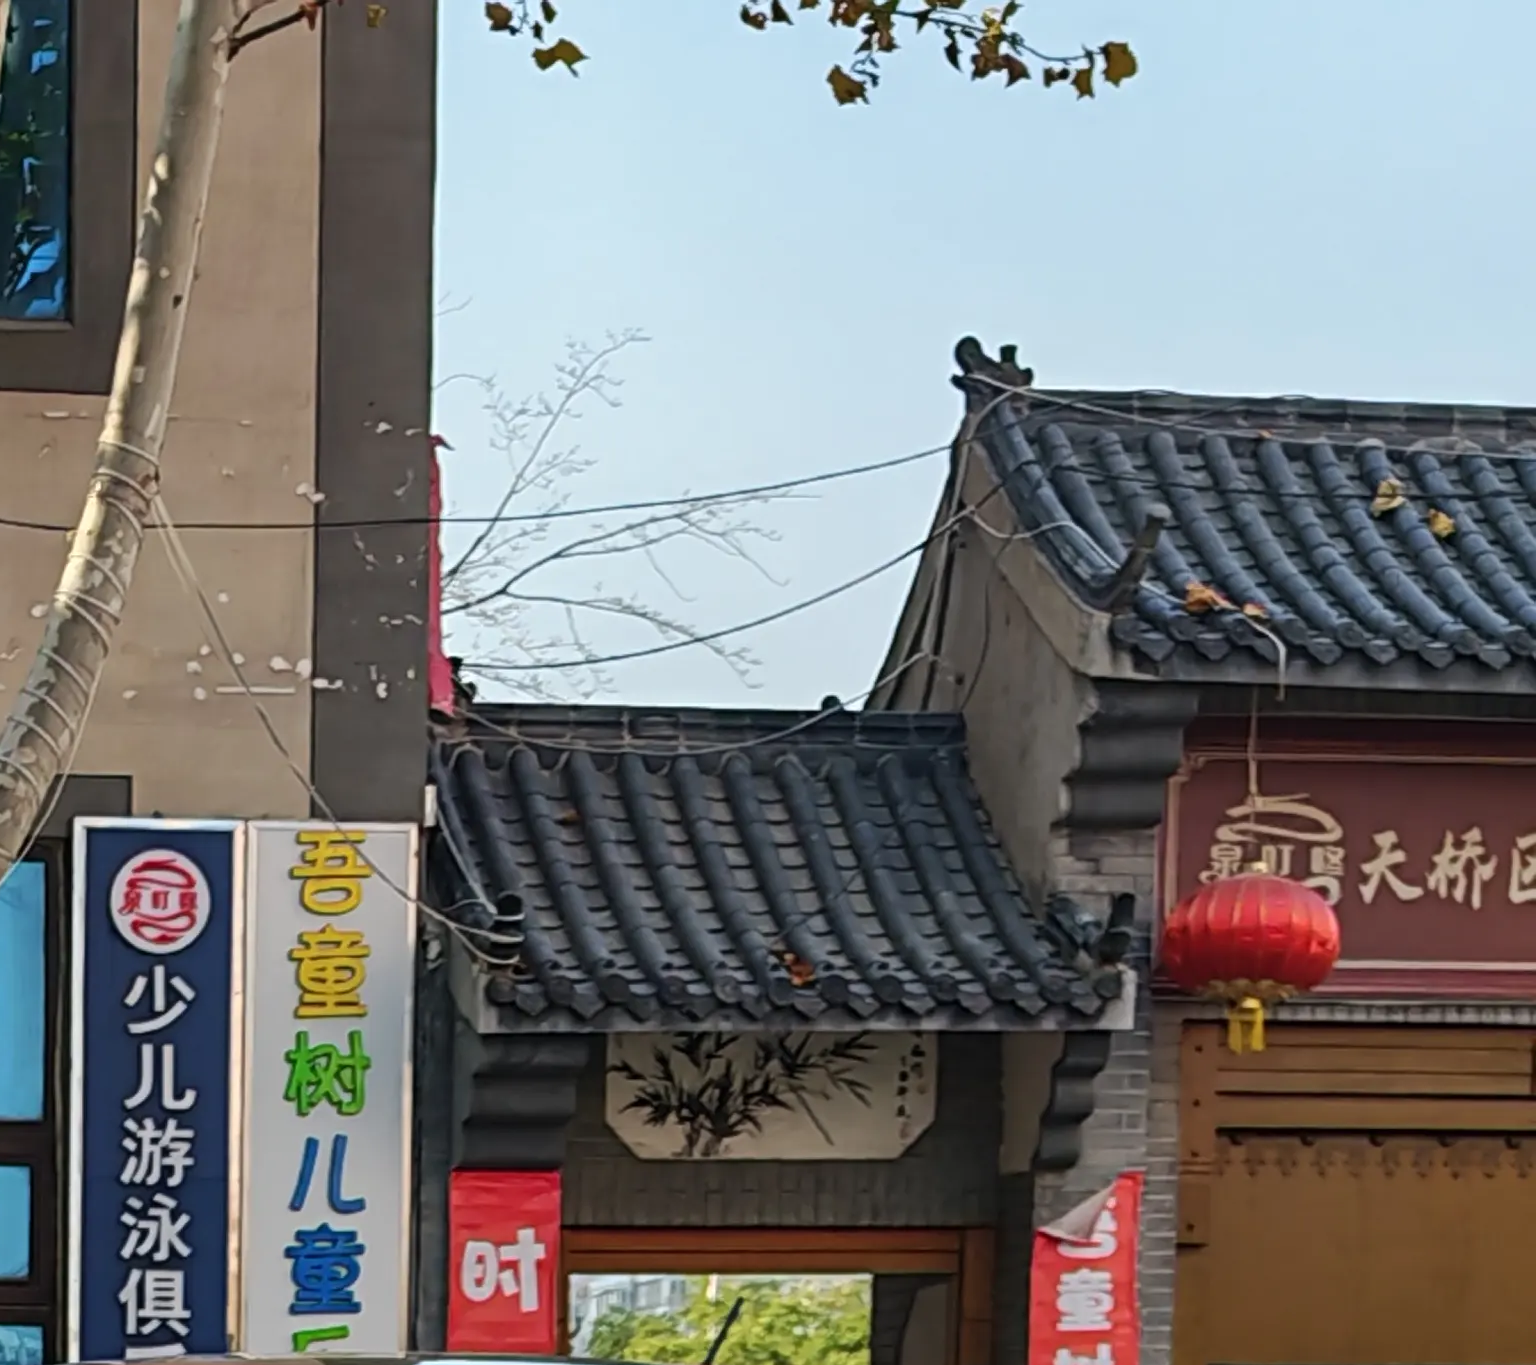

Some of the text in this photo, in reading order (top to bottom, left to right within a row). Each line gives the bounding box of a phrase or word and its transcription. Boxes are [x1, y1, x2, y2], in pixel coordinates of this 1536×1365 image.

[118, 964, 197, 1359] 少儿游泳俱
[283, 831, 373, 1352] 吾童树儿童
[460, 1227, 547, 1313] 时
